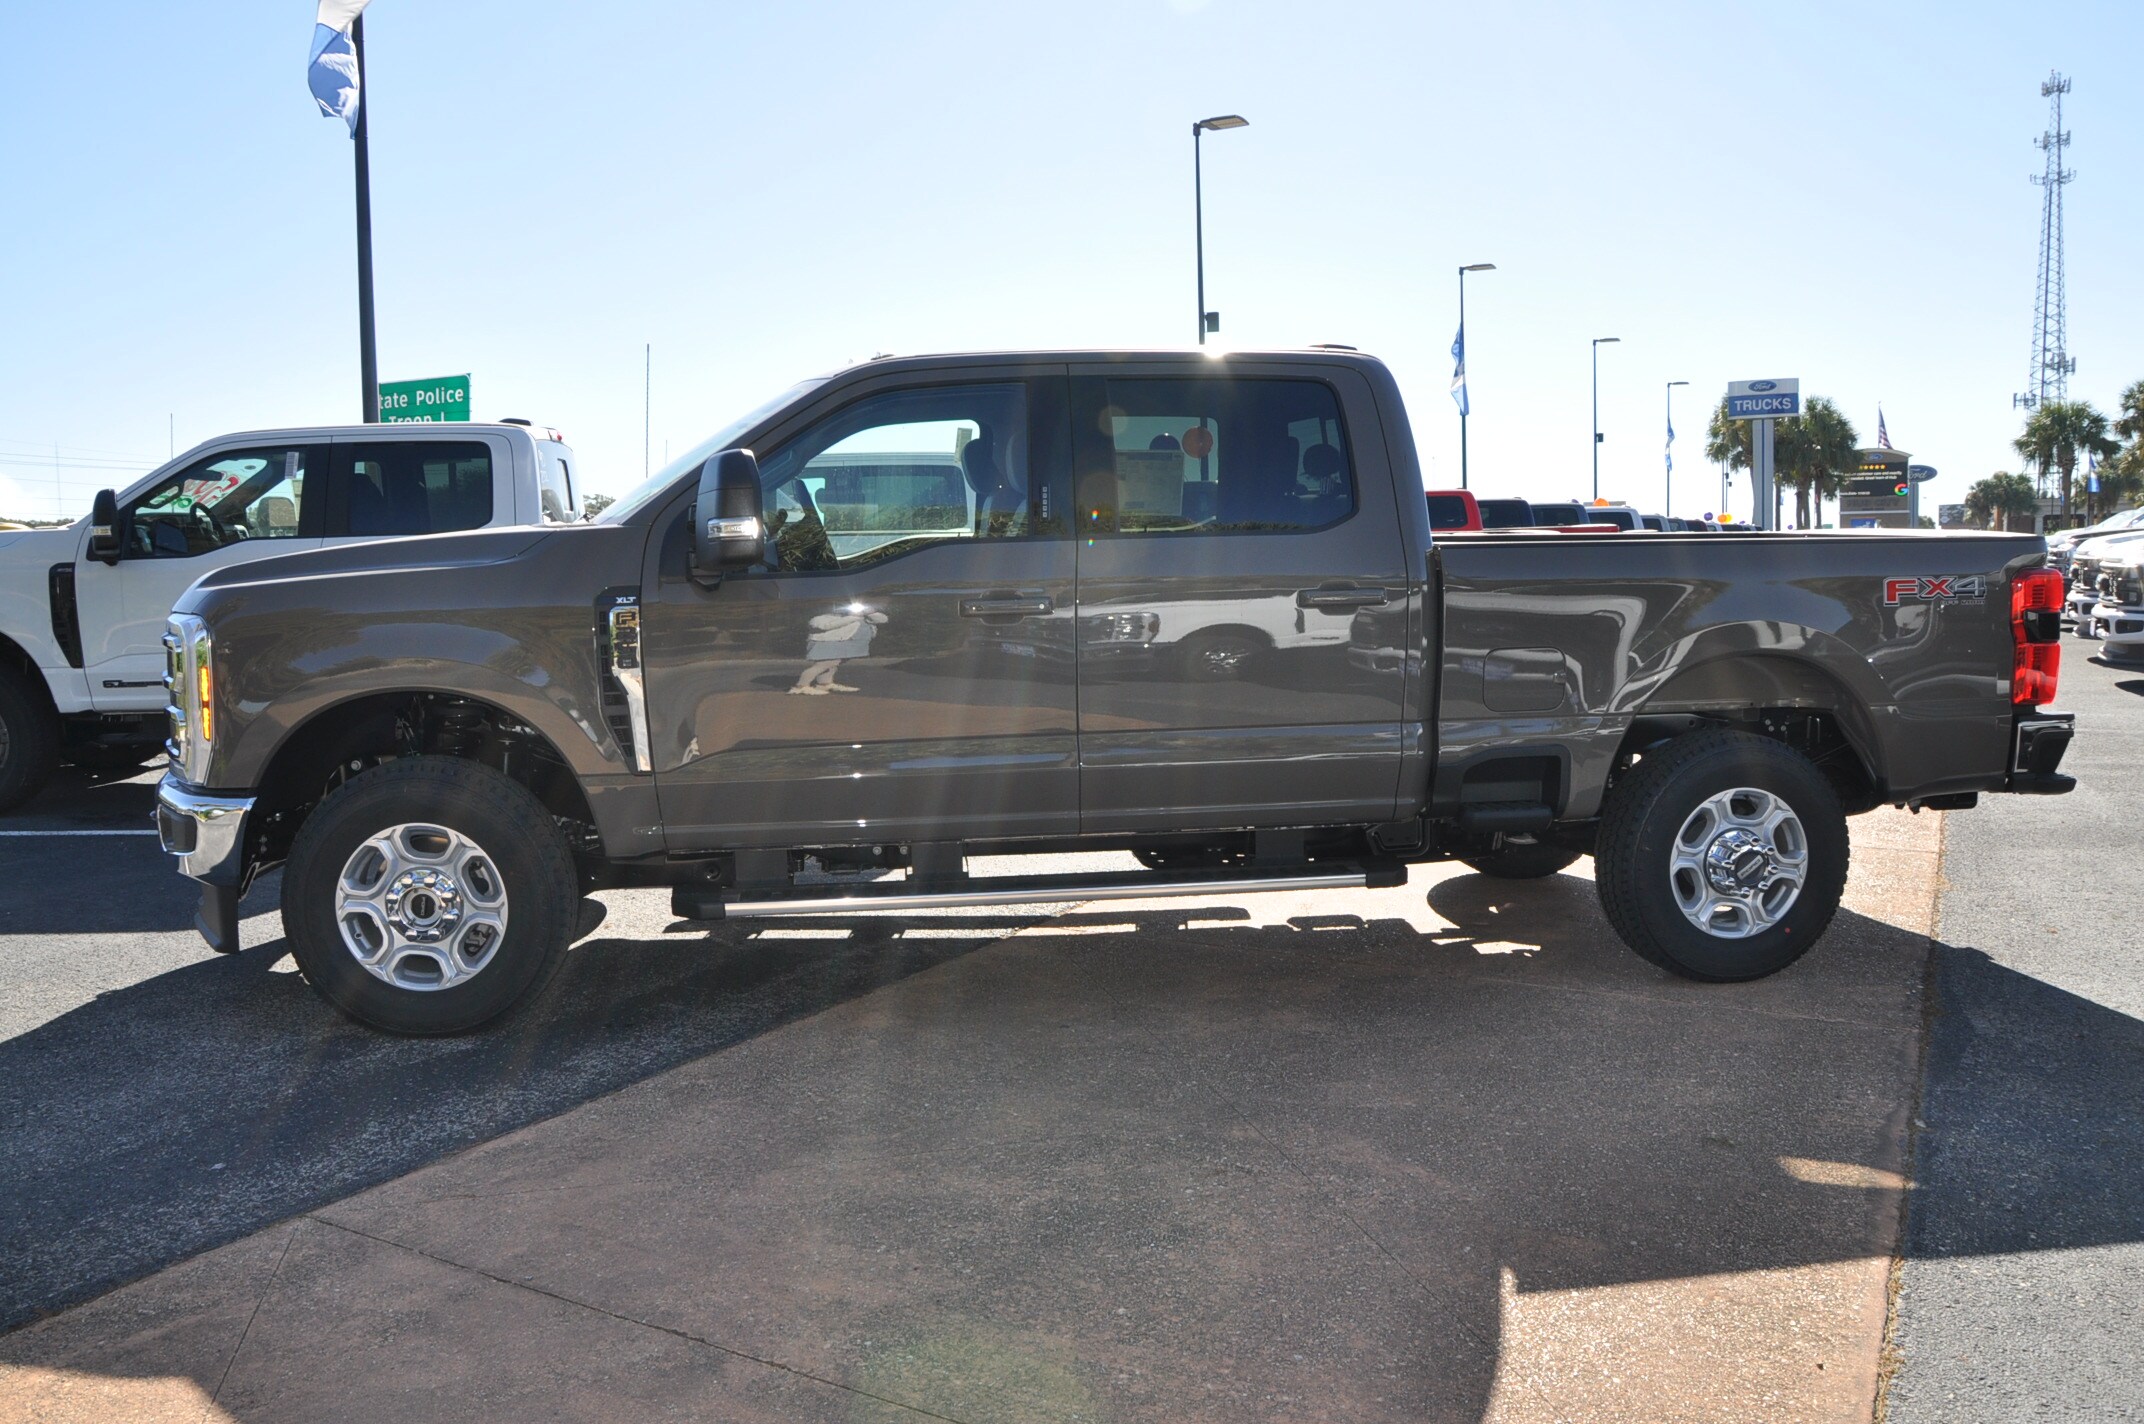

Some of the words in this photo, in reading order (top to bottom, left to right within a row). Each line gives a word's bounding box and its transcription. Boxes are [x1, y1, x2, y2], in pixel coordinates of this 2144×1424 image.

[416, 387, 464, 406] Police
[1734, 398, 1792, 412] TRUCKS
[1884, 576, 1986, 607] FX4
